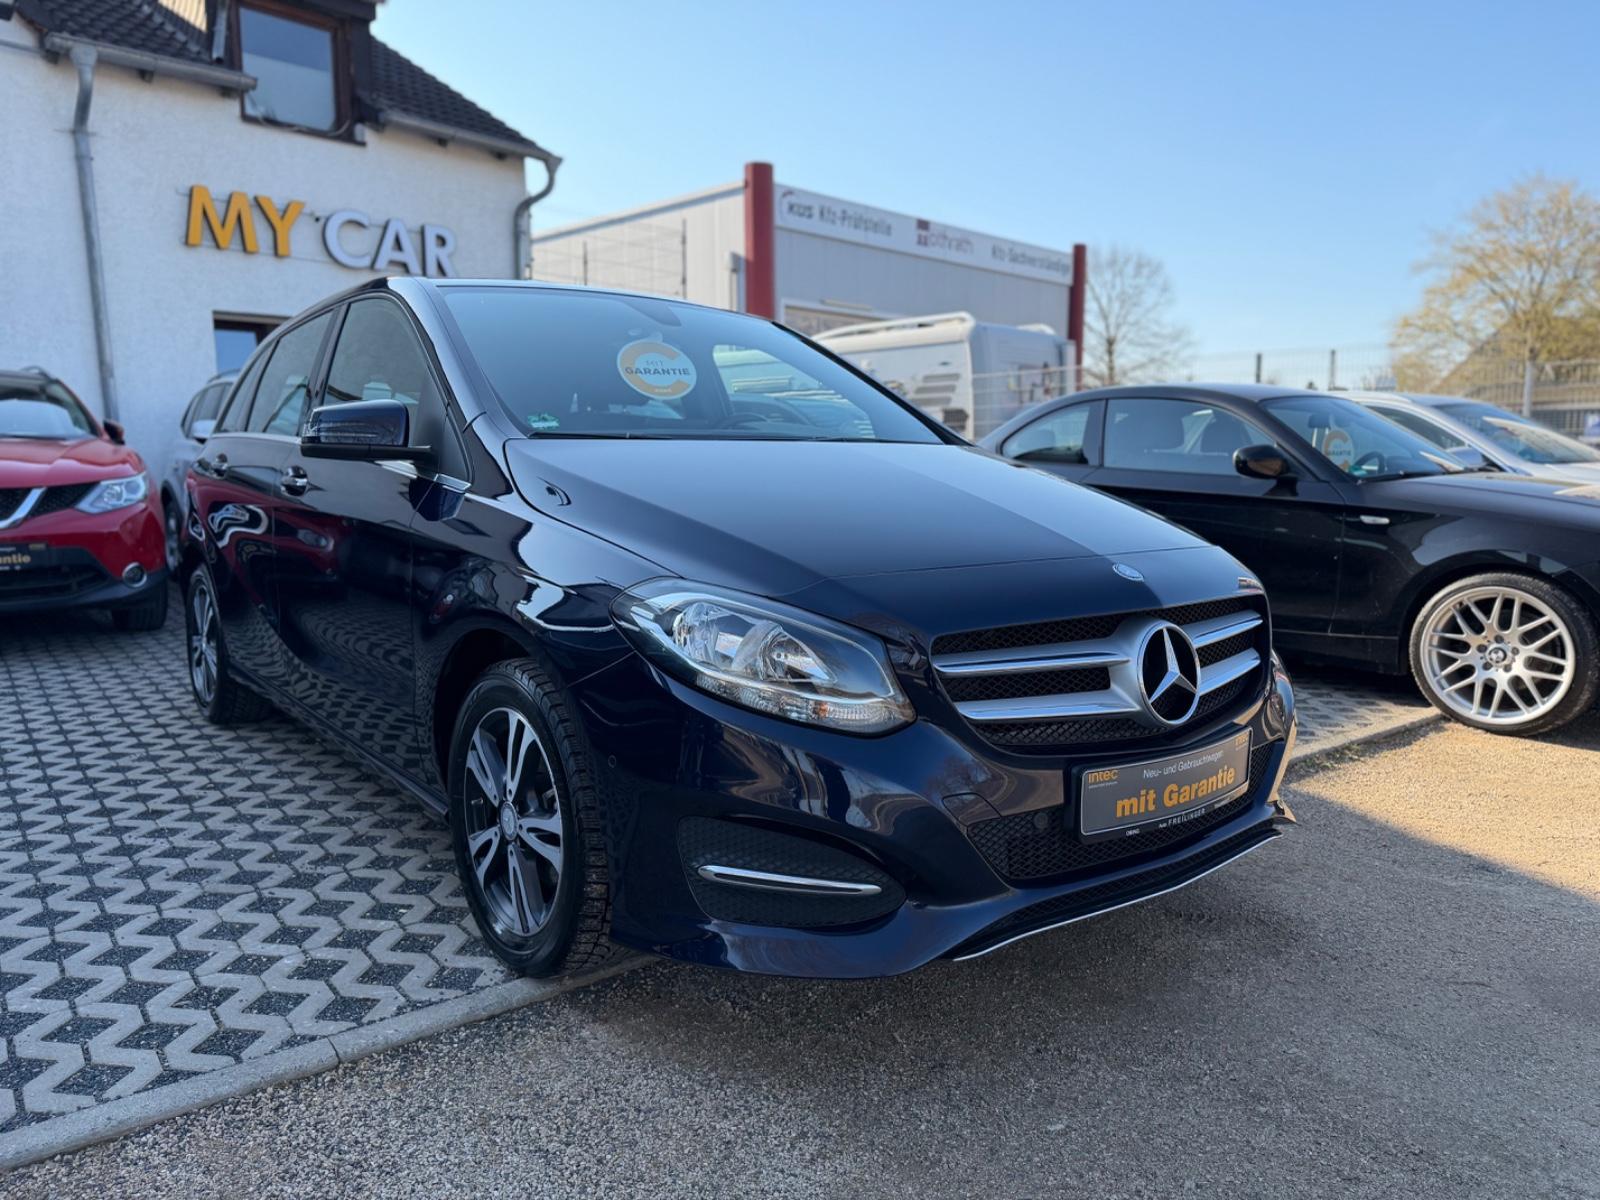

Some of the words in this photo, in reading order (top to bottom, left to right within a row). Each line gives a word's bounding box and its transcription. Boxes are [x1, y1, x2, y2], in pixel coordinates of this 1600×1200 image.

[186, 184, 304, 258] MY
[322, 208, 457, 277] CAR
[624, 367, 689, 376] GARANTIE
[1143, 768, 1161, 779] Neu-
[1163, 764, 1176, 775] und
[1116, 788, 1157, 818] mit
[1163, 766, 1236, 807] Garantie
[1168, 808, 1206, 826] FREILINGER
